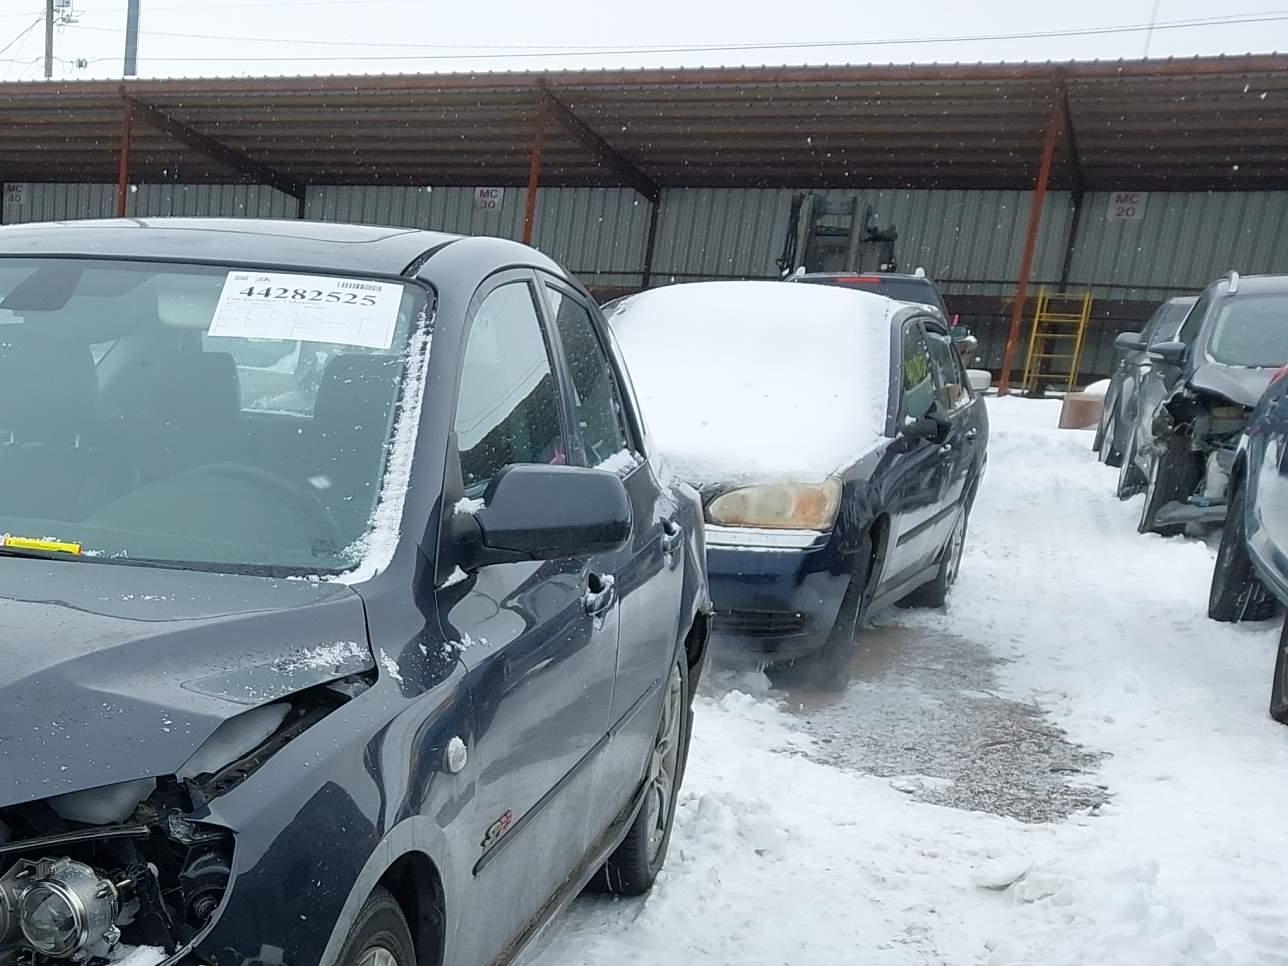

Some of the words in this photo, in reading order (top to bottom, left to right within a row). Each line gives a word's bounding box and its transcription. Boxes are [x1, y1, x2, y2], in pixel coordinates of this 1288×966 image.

[479, 188, 499, 199] MC
[1115, 193, 1140, 204] MC
[479, 200, 496, 209] 30
[1115, 206, 1137, 217] 20
[239, 284, 377, 307] 44282525
